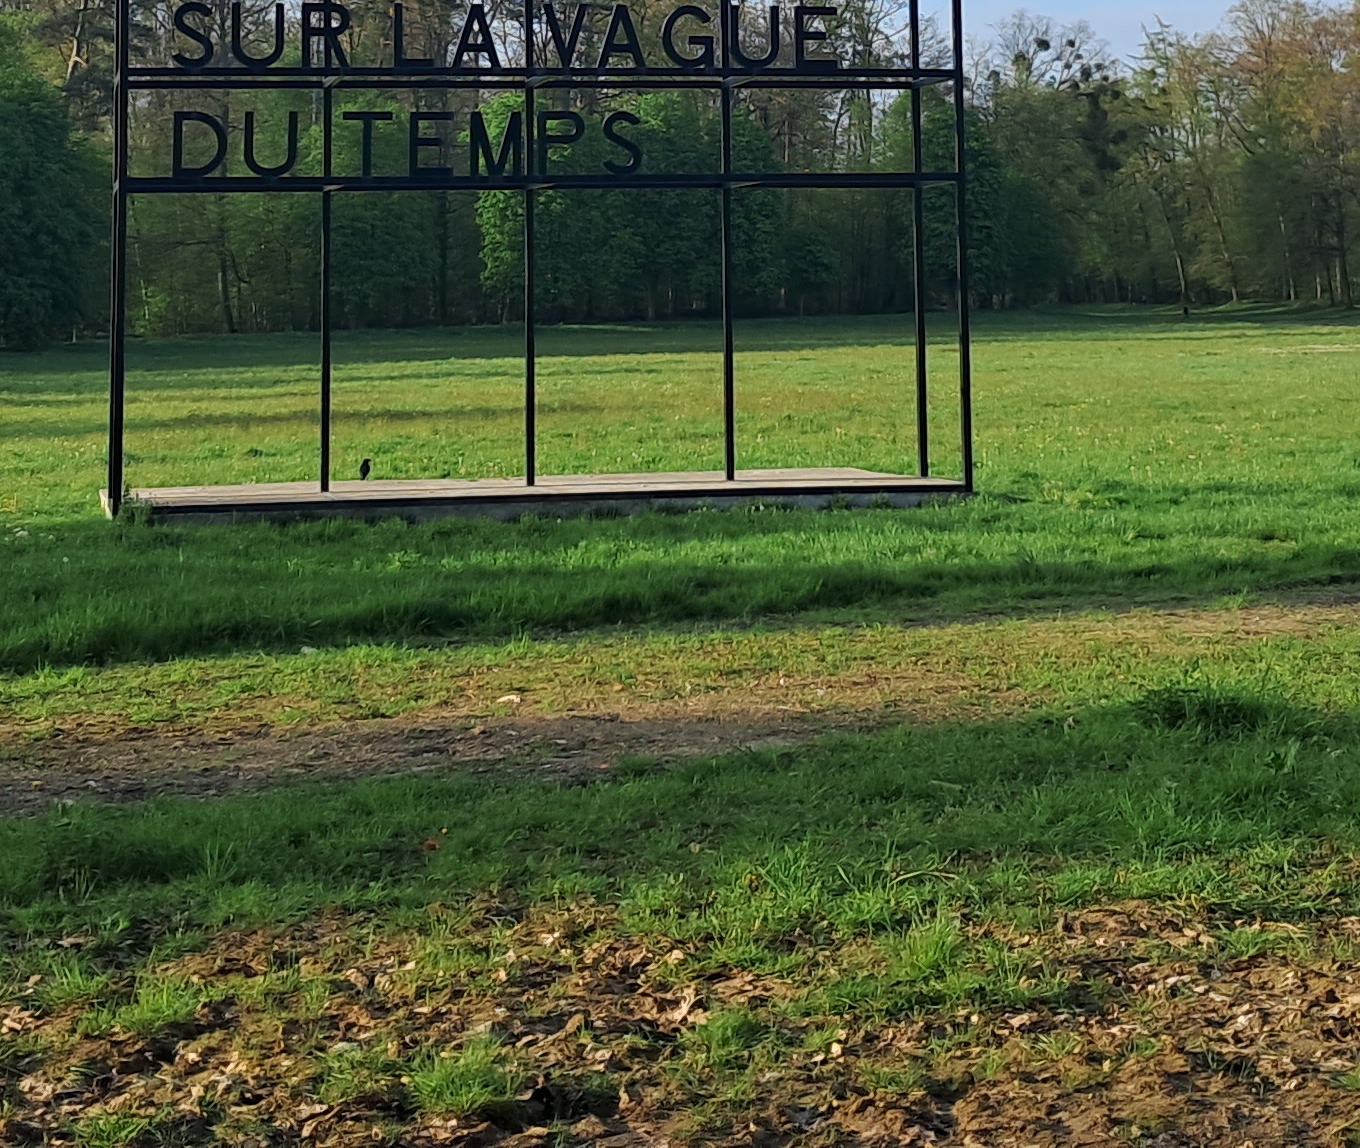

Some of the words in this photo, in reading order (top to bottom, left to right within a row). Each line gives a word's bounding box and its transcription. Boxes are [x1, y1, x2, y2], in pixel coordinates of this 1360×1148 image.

[172, 2, 350, 69] SUR
[393, 3, 501, 69] LA
[543, 3, 838, 70] VAGUE
[172, 110, 298, 177] DU
[343, 110, 641, 177] TEMPS
